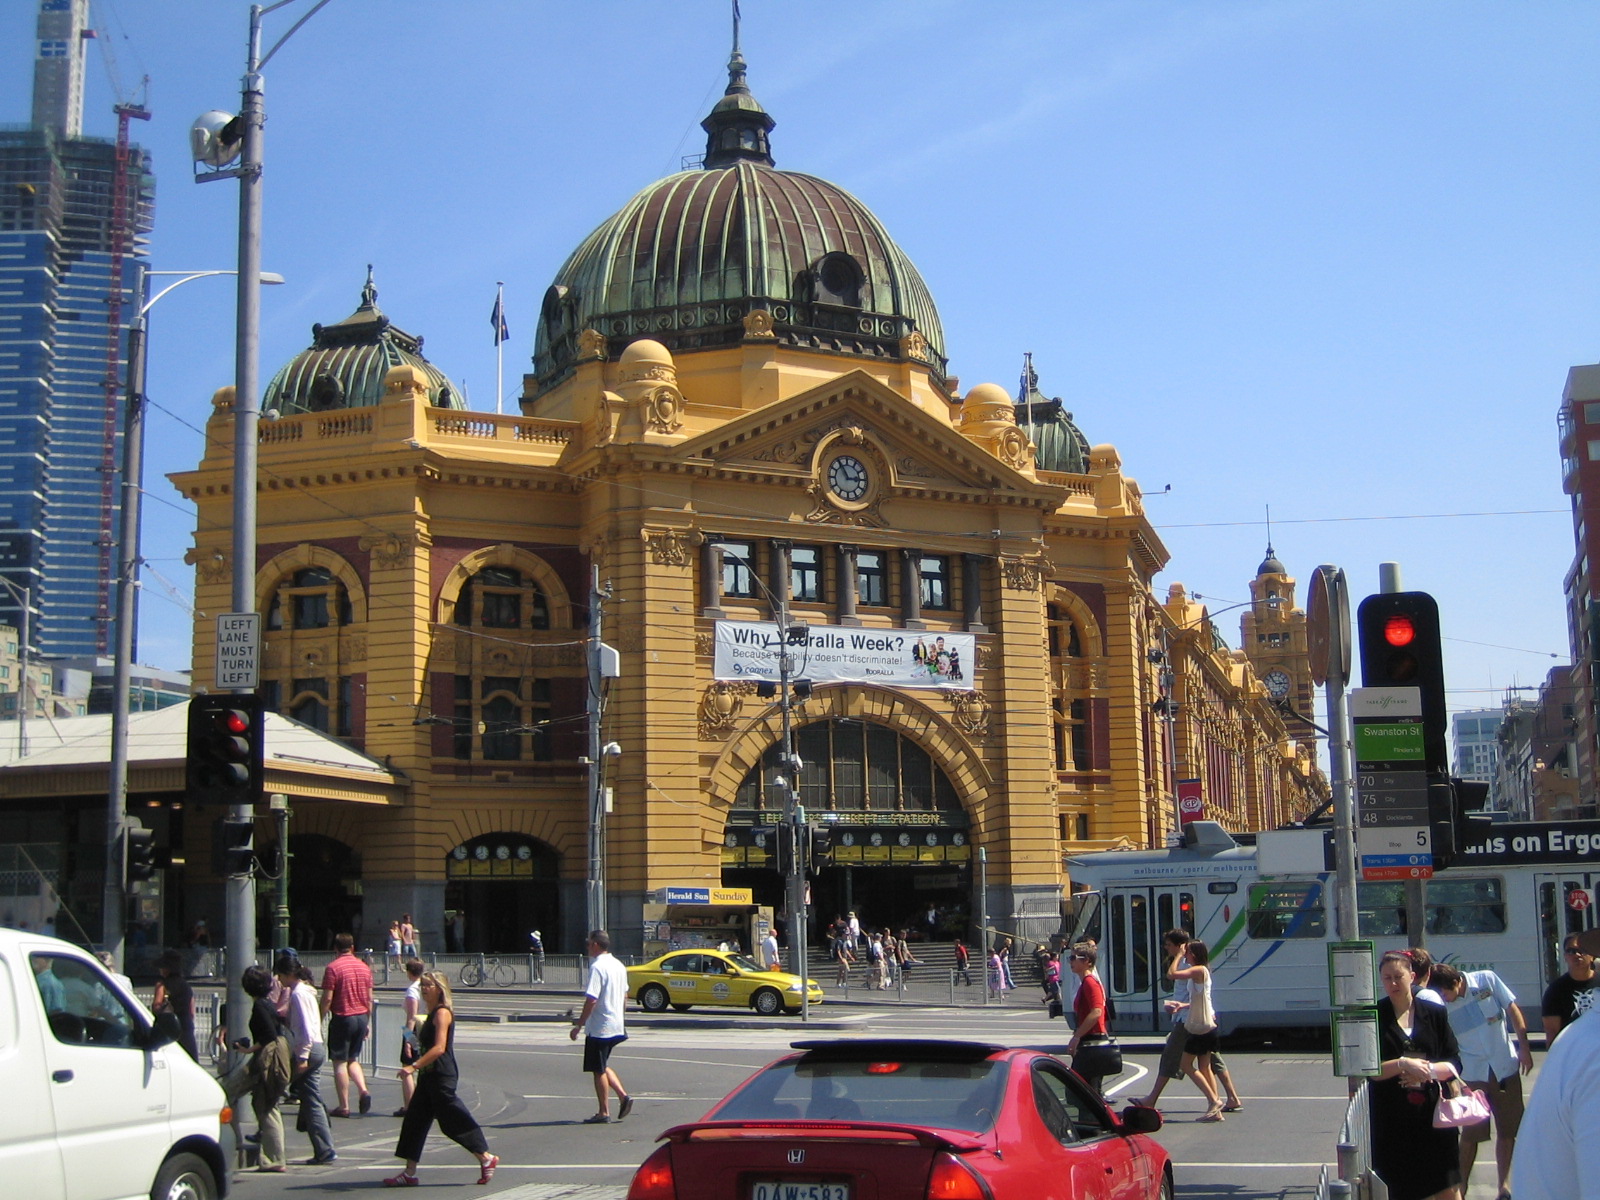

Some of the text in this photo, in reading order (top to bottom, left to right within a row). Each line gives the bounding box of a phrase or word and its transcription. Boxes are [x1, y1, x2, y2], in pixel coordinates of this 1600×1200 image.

[224, 620, 252, 630] LEFT
[219, 632, 249, 643] LANE
[733, 628, 771, 649] Why
[850, 634, 904, 652] Week?
[221, 646, 254, 656] MUST
[732, 649, 772, 660] Because
[815, 653, 848, 663] doesn't
[849, 654, 903, 665] discriminate!
[222, 660, 253, 669] TURN
[744, 665, 774, 675] connex
[222, 672, 251, 683] LEFT
[1363, 727, 1420, 736] Swanston St
[1360, 776, 1375, 787] 70
[1185, 800, 1197, 808] GP
[1362, 794, 1377, 805] 75
[890, 813, 940, 825] STATION
[1363, 812, 1378, 823] 48
[1416, 831, 1427, 846] 5
[1512, 836, 1542, 852] on
[1133, 867, 1174, 875] melbourne
[668, 892, 748, 902] Herald Sun Sunday
[1570, 890, 1586, 899] STOP
